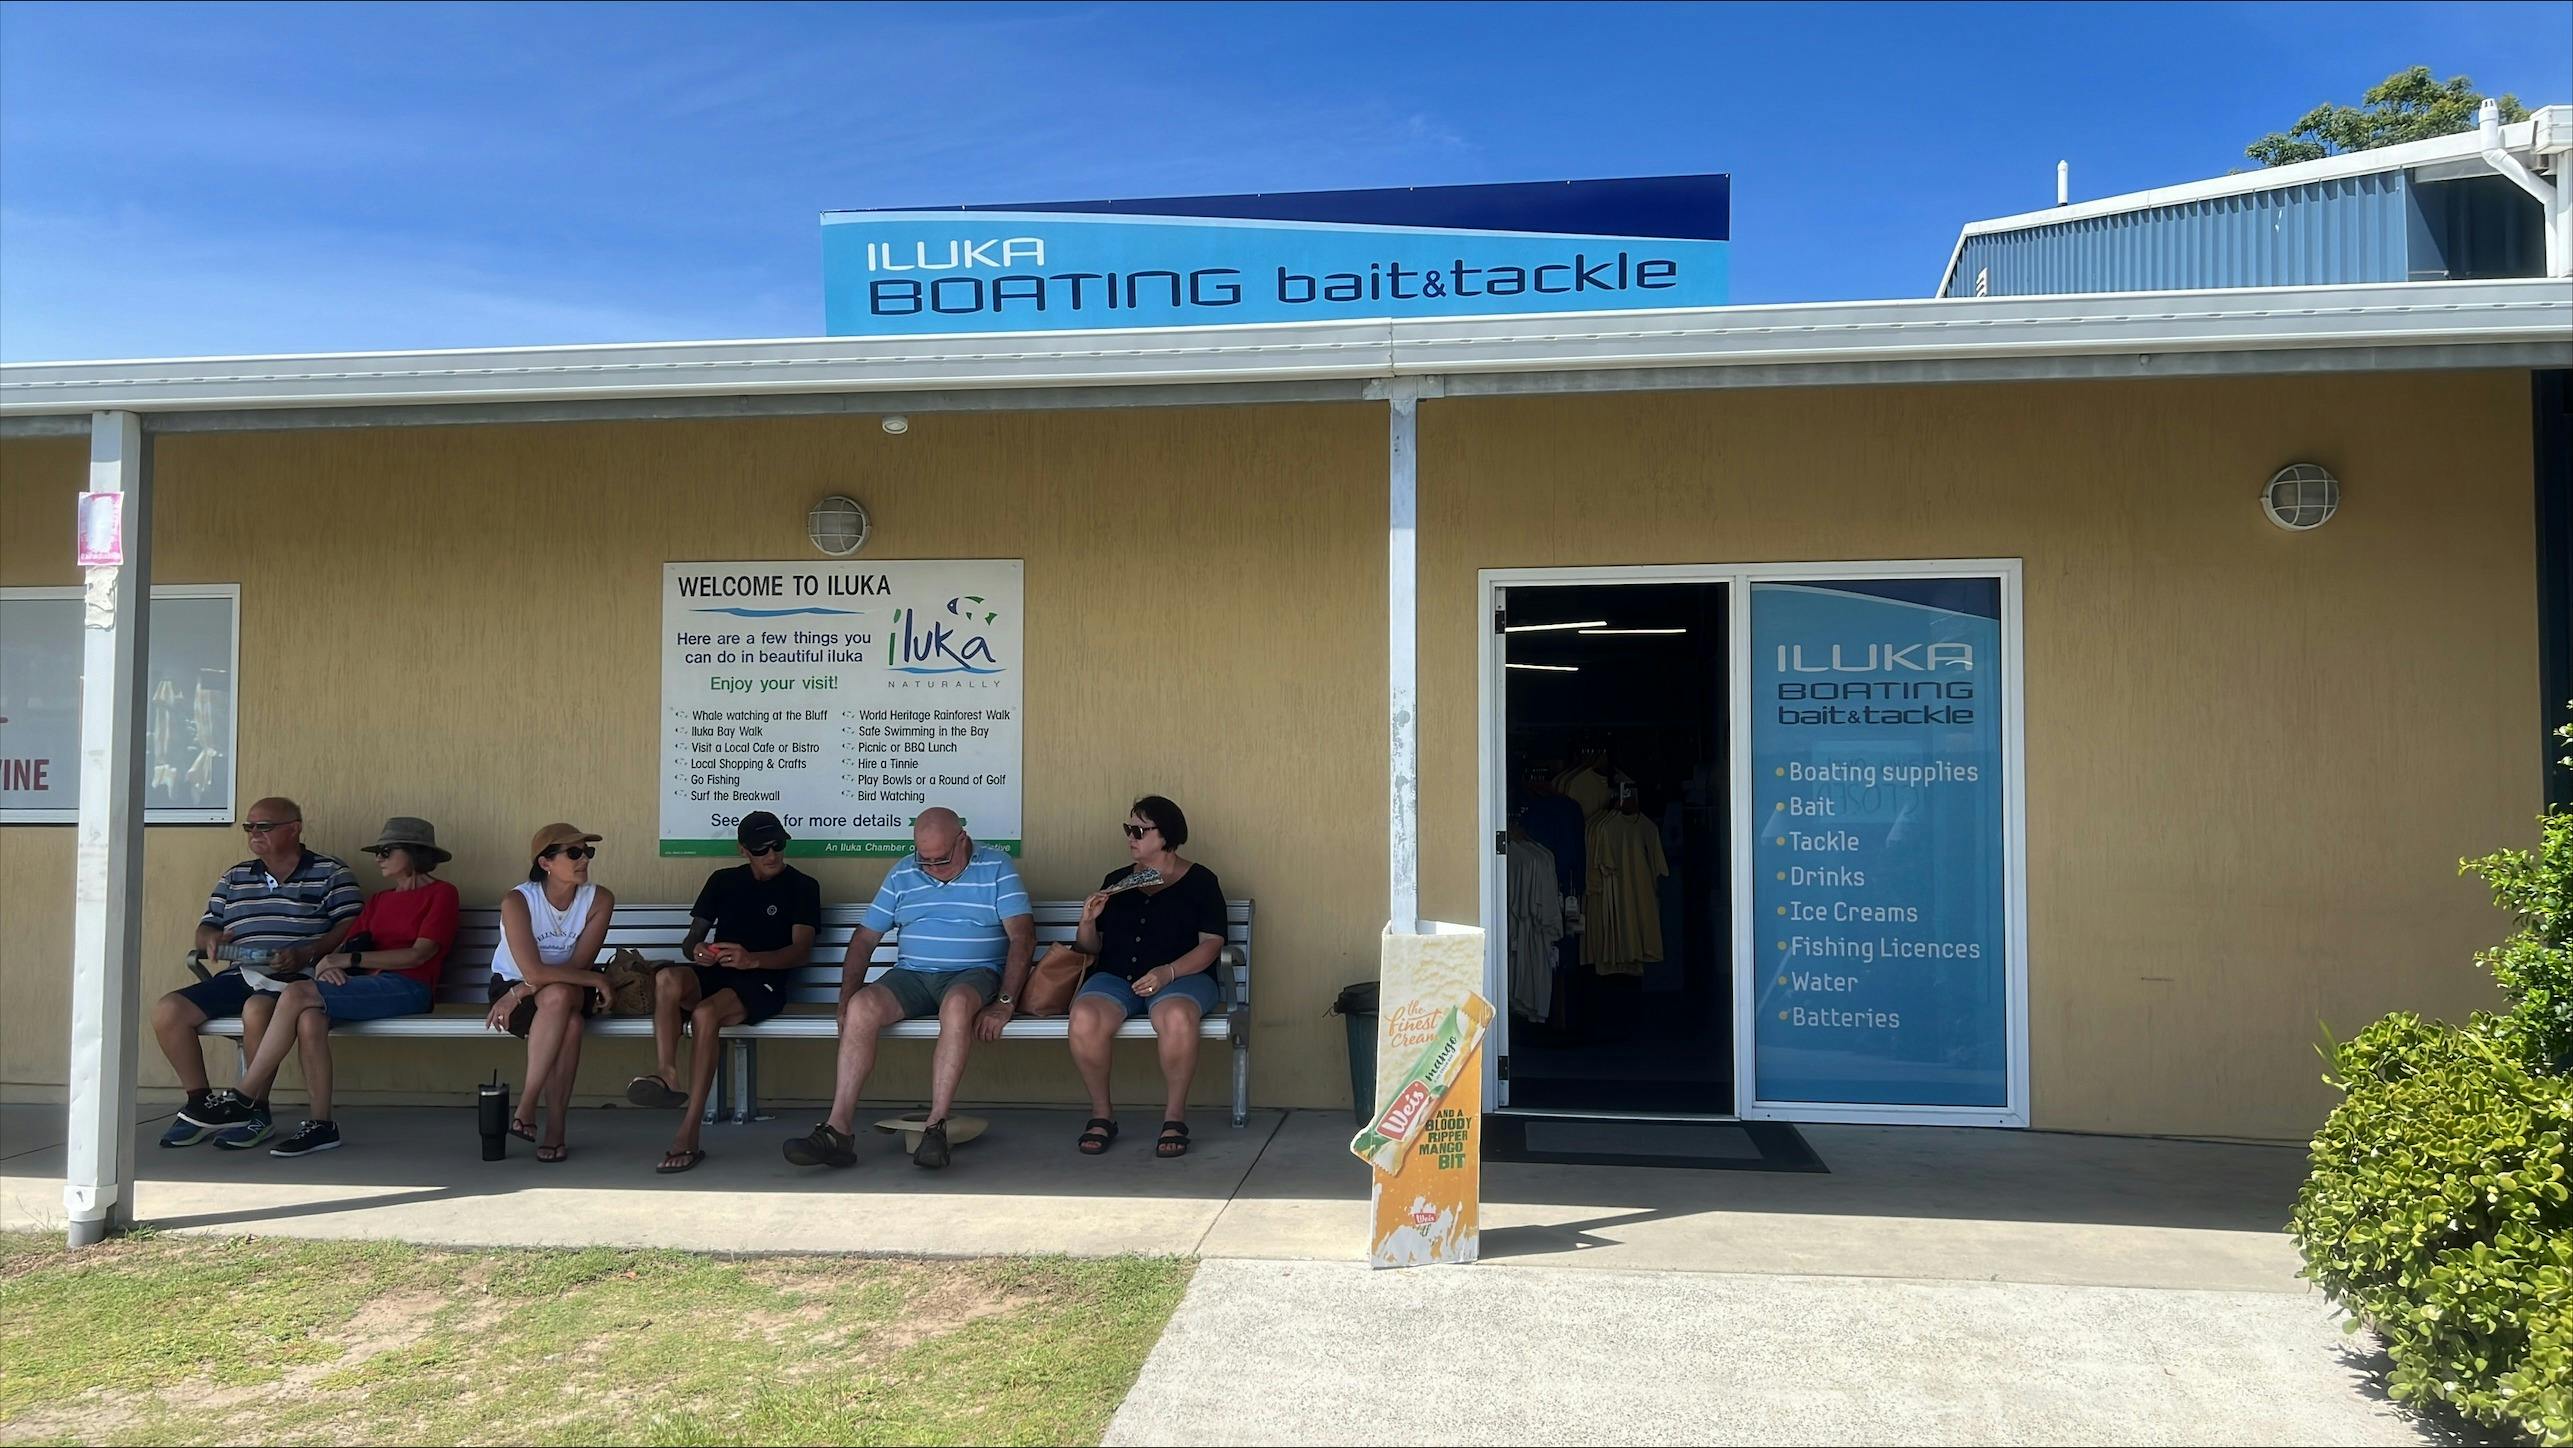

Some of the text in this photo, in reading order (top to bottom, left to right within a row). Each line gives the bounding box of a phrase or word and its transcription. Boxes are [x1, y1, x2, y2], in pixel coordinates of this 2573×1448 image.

[867, 237, 1045, 271] ILUKA
[869, 251, 1678, 315] BOATING bait&tackle
[678, 574, 891, 597] WELCOME TO ILUKA
[677, 631, 871, 646] Here are a few things you
[889, 608, 996, 669] iluka
[685, 649, 863, 663] can do in beautiful iluka
[1777, 642, 1974, 672] ILUKA
[710, 675, 838, 693] Enjoy your visit!
[1778, 681, 1974, 700] BOATING
[692, 710, 828, 723] Whale watching at the Bluff
[860, 710, 1010, 722] World Heritage Rainforest Walk
[1778, 705, 1974, 724] bait&tackle
[692, 726, 763, 739] Iluka Bay Walk
[859, 726, 989, 739] Safe Swimming in the Bay
[692, 742, 820, 752] Visit a Local Cafe or Bistro
[858, 742, 957, 752] Picnic or BBQ Lunch
[691, 758, 807, 771] Local Shopping & Crafts
[858, 758, 919, 768] Hire a Tinnie
[0, 759, 49, 790] INE
[691, 774, 740, 787] Go Fishing
[858, 774, 1006, 787] Play Bowls or a Round of Golf
[1790, 761, 1979, 788] Boating supplies
[691, 790, 780, 800] Surf the Breakwall
[858, 790, 925, 803] Bird Watching
[1790, 797, 1835, 816] Bait
[711, 813, 902, 827] See for more details
[825, 843, 838, 852] An
[840, 842, 862, 852] Iluka
[865, 842, 906, 852] Chamber
[1789, 830, 1859, 851] Tackle
[1791, 866, 1865, 887] Drinks
[1790, 901, 1918, 923] Ice Creams
[1791, 936, 1980, 963] Fishing Licences
[1791, 971, 1858, 992] Water
[1407, 999, 1423, 1016] the
[1793, 1006, 1900, 1028] Batteries
[1424, 1036, 1457, 1081] mango
[1380, 1089, 1425, 1135] Weis
[1436, 1108, 1463, 1118] AND A
[1425, 1117, 1472, 1131] BLOODY
[1428, 1130, 1468, 1142] RIPPER
[1420, 1142, 1463, 1156] MANGO
[1439, 1154, 1465, 1170] BIT
